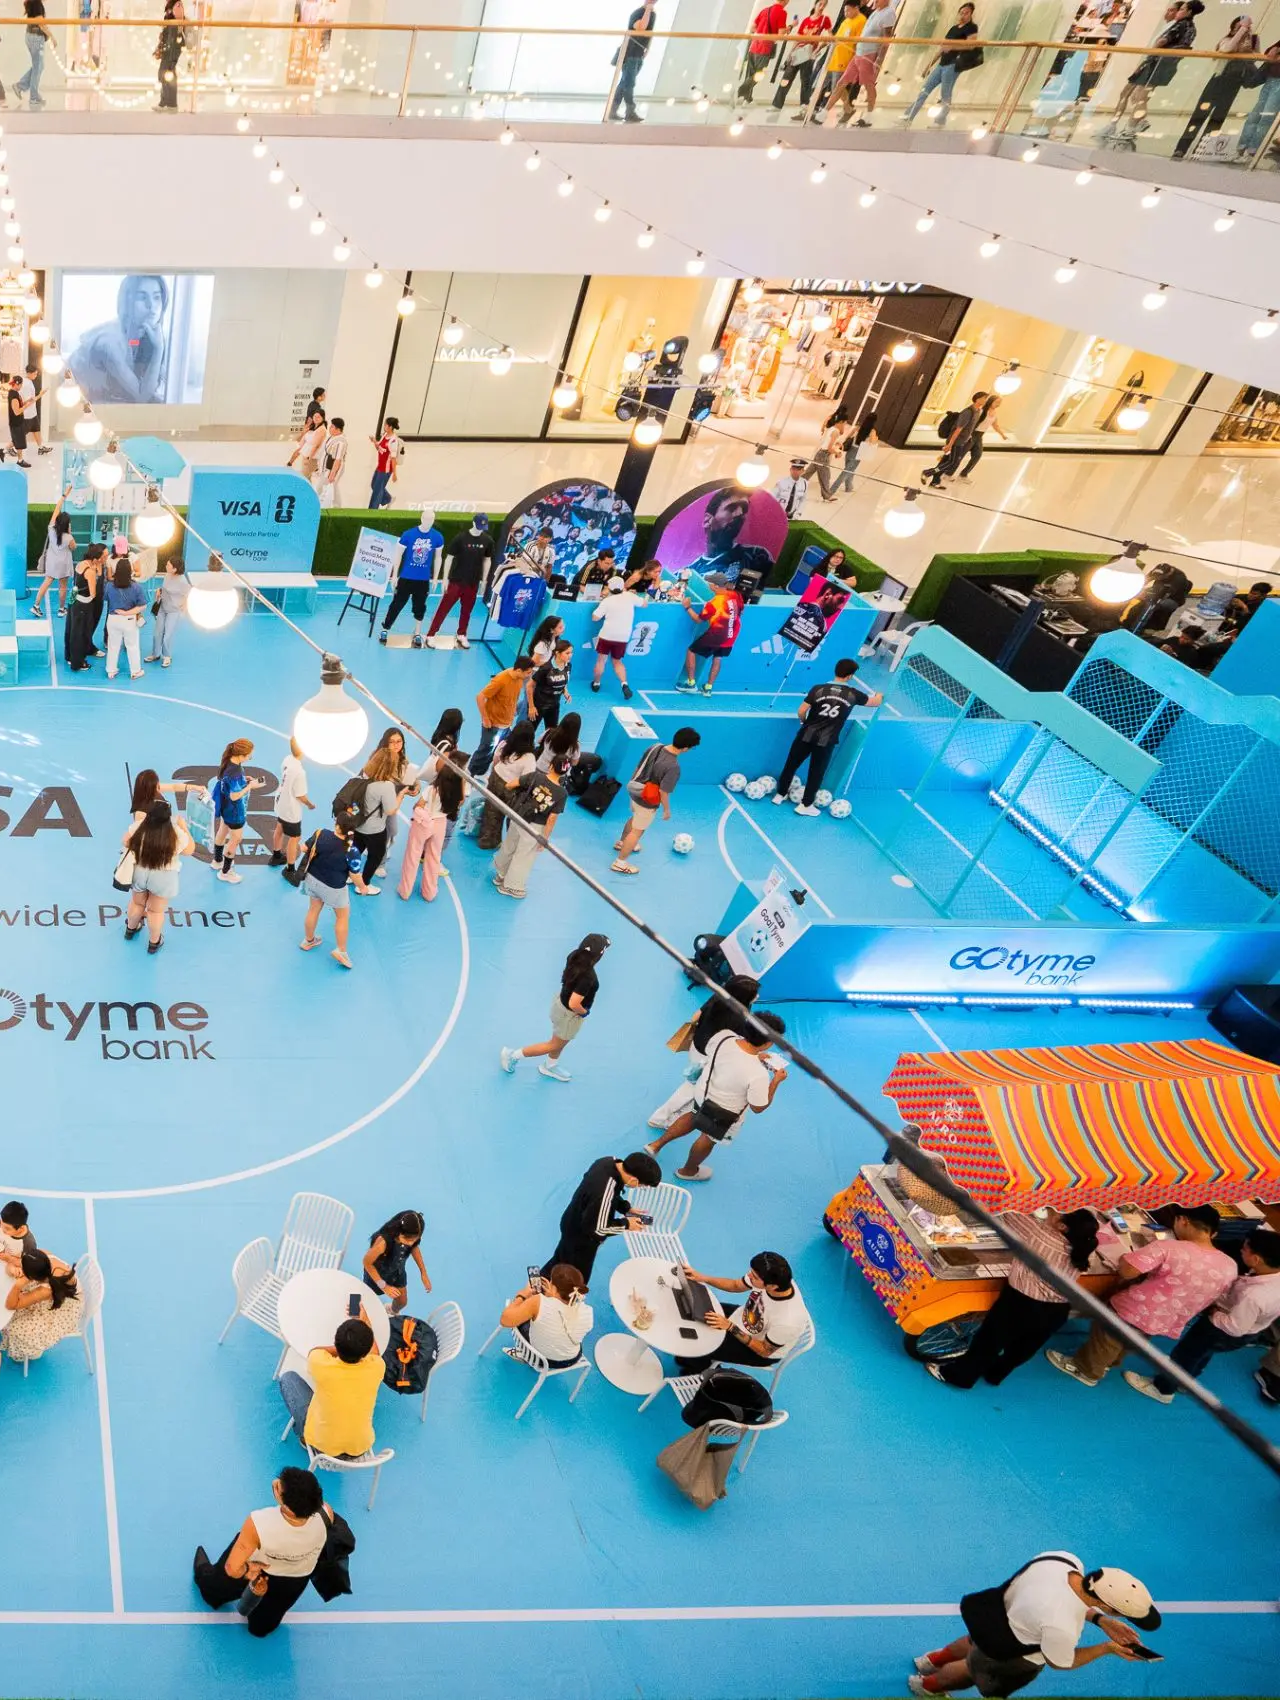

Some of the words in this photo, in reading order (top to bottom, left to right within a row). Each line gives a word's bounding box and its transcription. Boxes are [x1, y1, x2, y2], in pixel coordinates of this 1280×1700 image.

[218, 500, 261, 516] VISA
[230, 548, 268, 558] GOtyme
[819, 703, 840, 718] 26
[99, 905, 251, 928] Ptner
[760, 908, 774, 929] Goal
[770, 925, 785, 948] Tyme
[949, 946, 1096, 976] GOtyme
[1024, 972, 1084, 985] bank
[101, 1034, 216, 1060] bank
[866, 1239, 885, 1263] AURO
